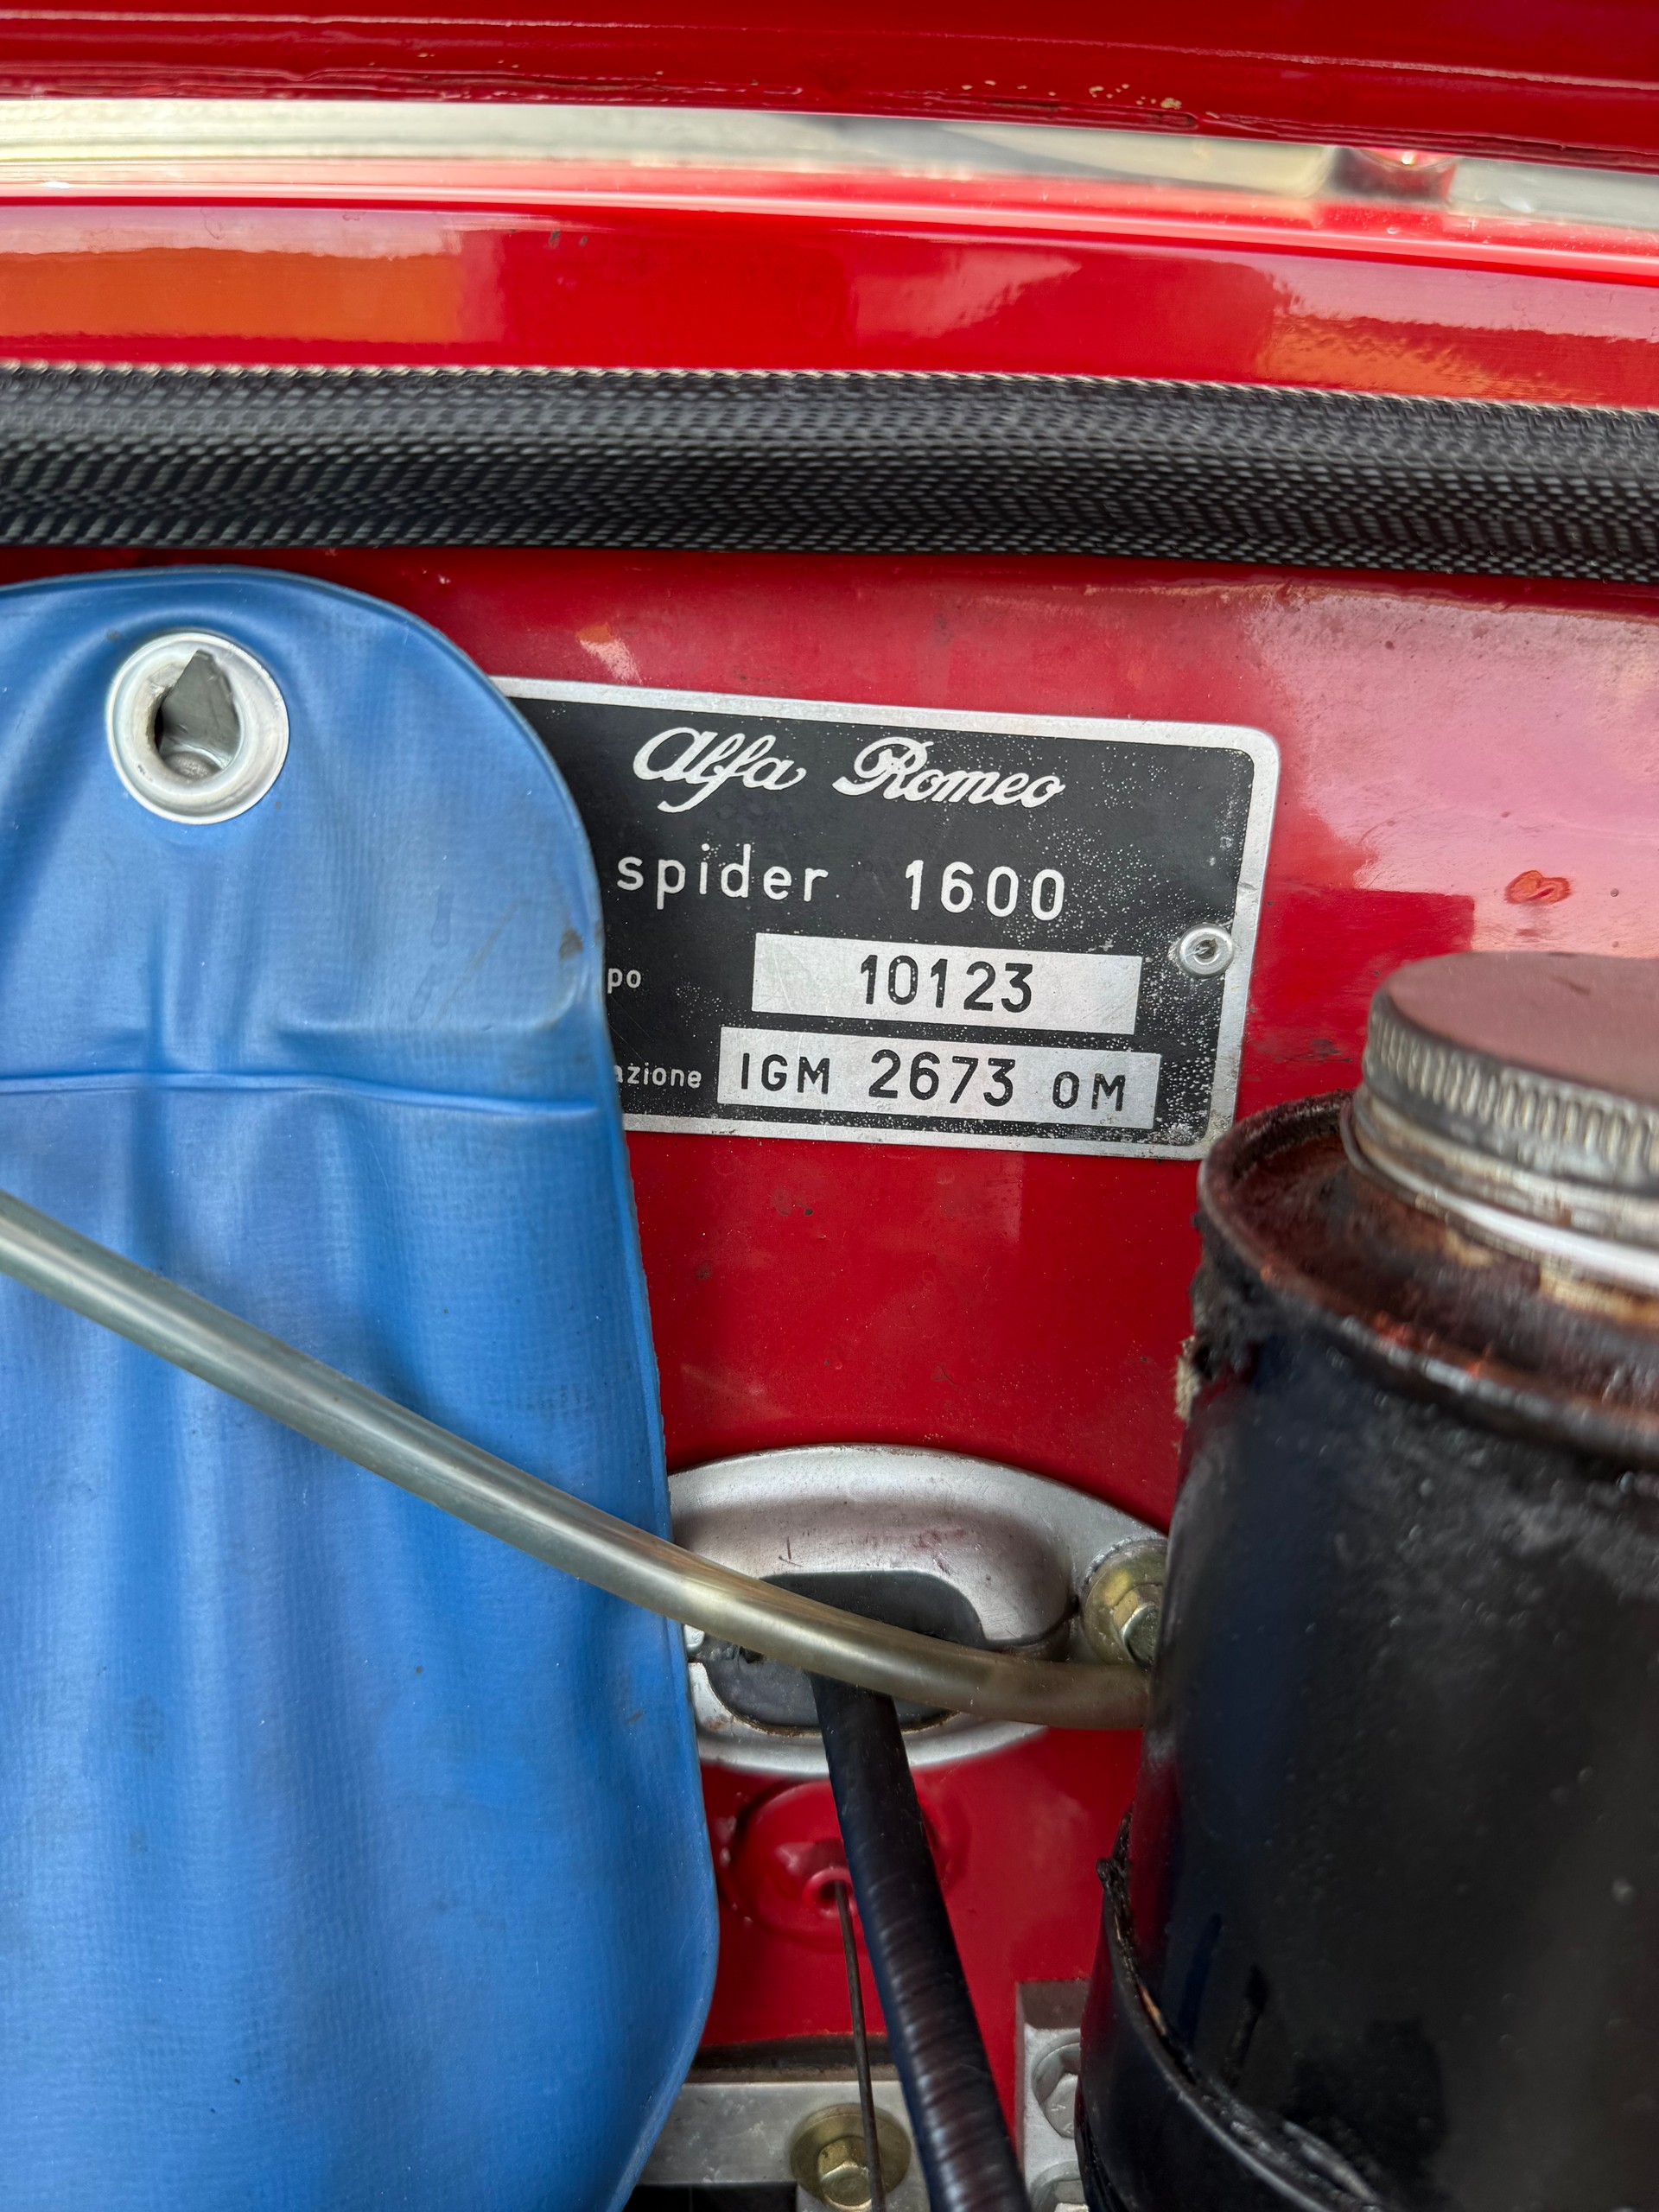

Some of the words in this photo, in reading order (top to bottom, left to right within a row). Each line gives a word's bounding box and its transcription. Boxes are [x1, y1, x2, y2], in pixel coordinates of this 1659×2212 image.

[633, 727, 806, 813] Alfa
[832, 736, 1066, 808] Romeo
[617, 843, 829, 910] spider
[906, 860, 1065, 921] 1600
[860, 954, 1033, 1013] 10123
[741, 1052, 830, 1096] IGM
[868, 1049, 1016, 1108] 2673
